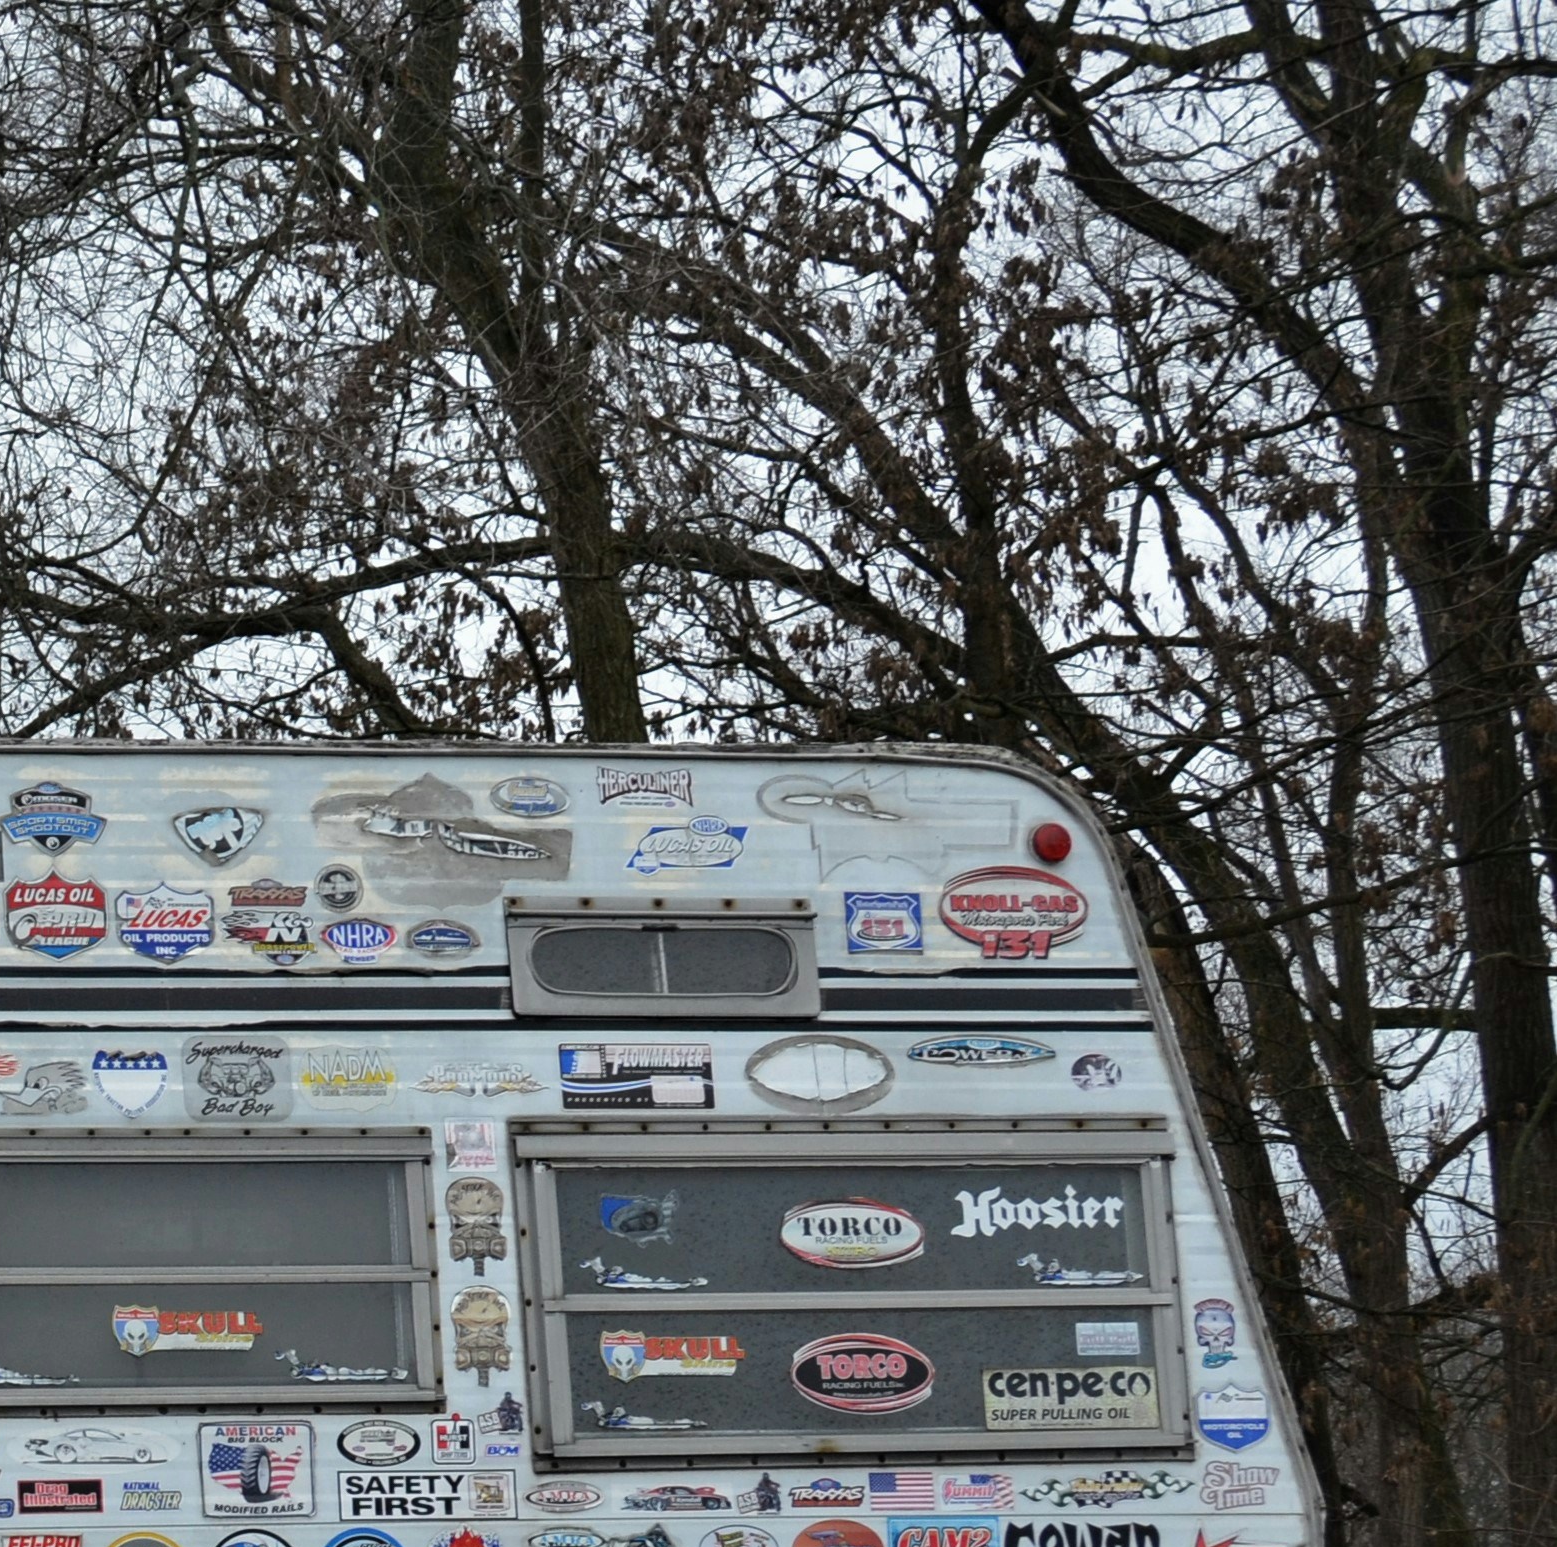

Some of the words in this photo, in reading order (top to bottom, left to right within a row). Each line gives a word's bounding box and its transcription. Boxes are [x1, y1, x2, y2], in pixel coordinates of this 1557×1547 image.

[597, 766, 693, 803] HERCULINER
[13, 887, 67, 904] LUCAS
[69, 887, 95, 903] OIL
[950, 893, 1079, 913] KNOLL-GAS
[129, 909, 209, 928] LUCAS
[122, 933, 143, 943] OIL
[146, 932, 209, 944] PRODUCTS
[333, 925, 385, 946] NHRA
[202, 1098, 235, 1116] Bad
[239, 1099, 274, 1118] Boy
[950, 1184, 1123, 1238] Hoosier
[797, 1216, 902, 1238] TORCO
[815, 1236, 854, 1245] RACING
[856, 1235, 887, 1244] FUELS
[991, 1408, 1037, 1421] SUPER
[1041, 1408, 1104, 1420] PULLING
[1107, 1407, 1131, 1420] OIL
[215, 1426, 296, 1437] AMERICAN
[35, 1483, 69, 1496] Drag
[346, 1475, 465, 1495] SAFETY
[23, 1493, 97, 1507] Illustrated
[214, 1504, 268, 1514] MODIFIED
[271, 1502, 305, 1513] RAILS
[352, 1497, 461, 1516] FIRST
